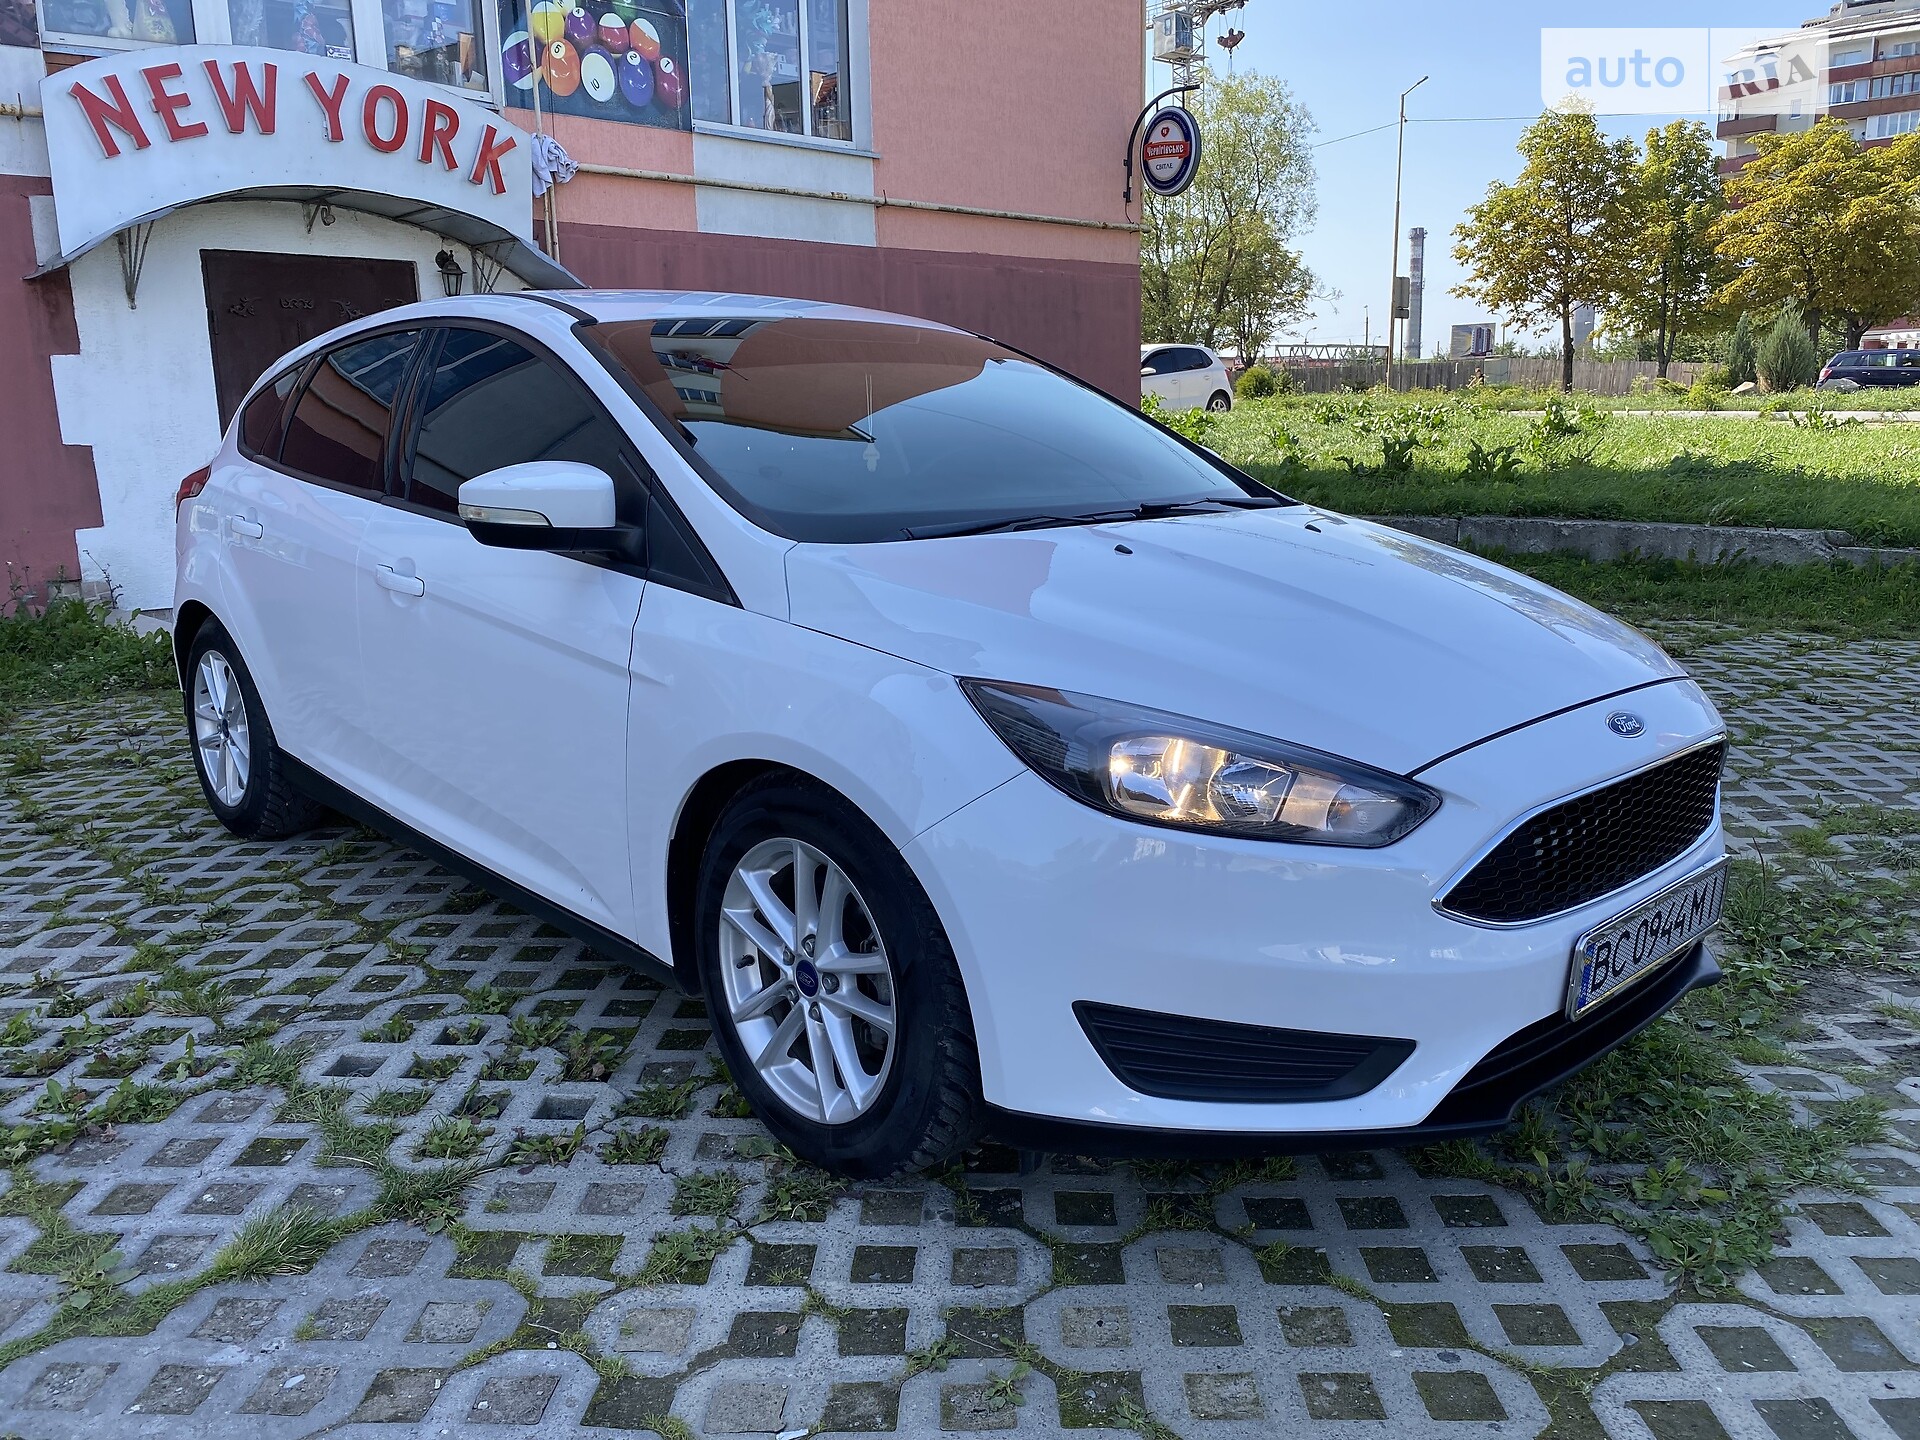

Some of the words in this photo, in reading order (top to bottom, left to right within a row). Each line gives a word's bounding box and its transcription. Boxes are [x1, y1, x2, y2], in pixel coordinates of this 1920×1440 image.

[68, 59, 278, 159] NEW
[304, 71, 517, 195] YORK
[1614, 715, 1640, 733] Ford
